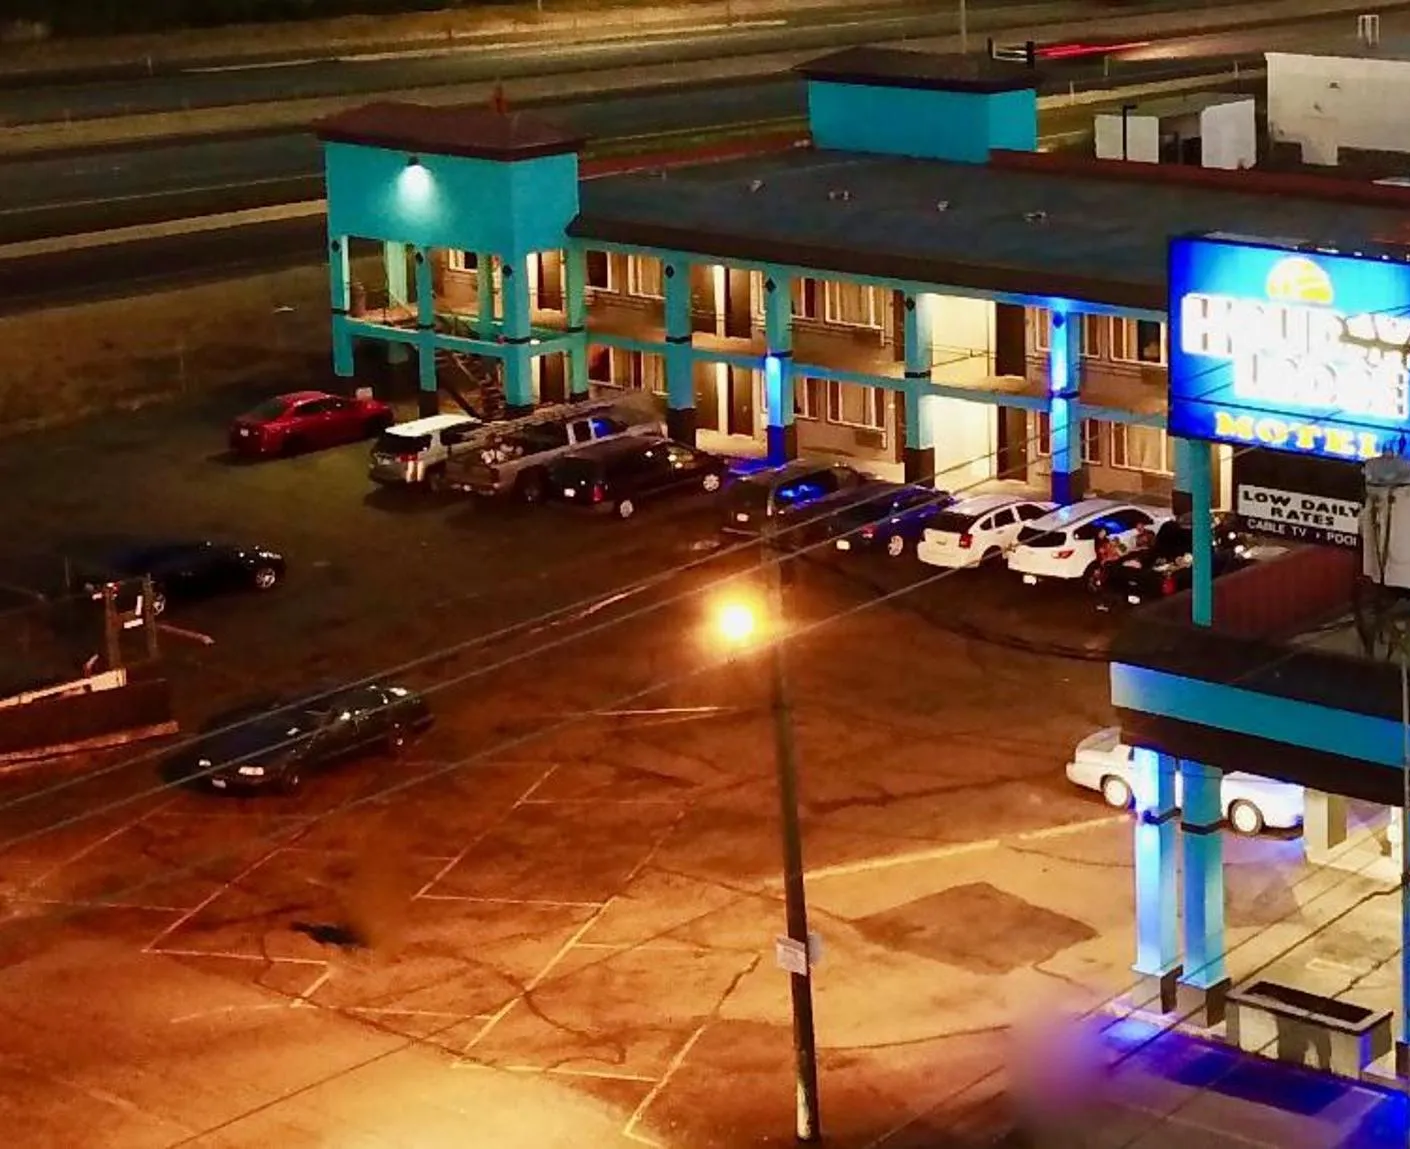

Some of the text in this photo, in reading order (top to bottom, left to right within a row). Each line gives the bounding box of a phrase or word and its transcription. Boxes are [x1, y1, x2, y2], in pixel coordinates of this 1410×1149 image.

[1215, 411, 1382, 458] MOTEL
[1243, 490, 1361, 518] LOW DAILY
[1247, 518, 1286, 536] CABLE
[1292, 526, 1307, 537] TV
[1270, 507, 1334, 526] RATES
